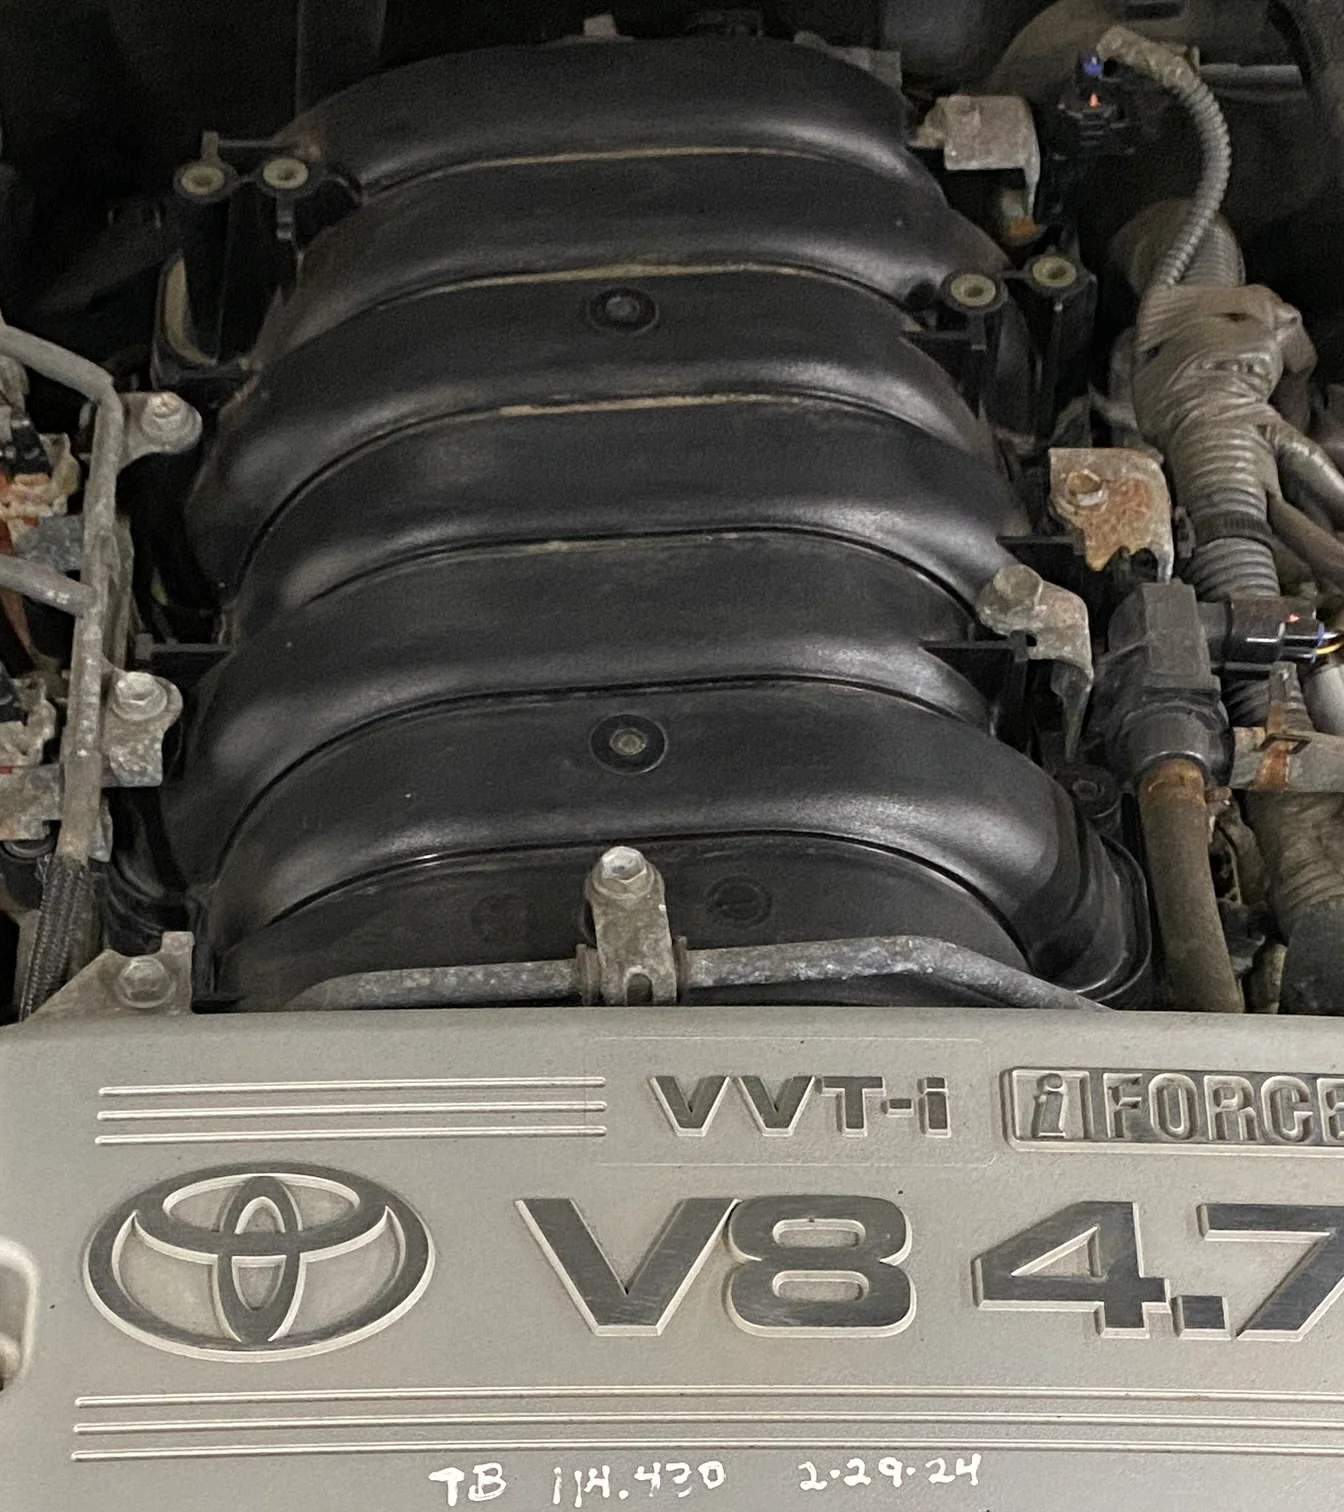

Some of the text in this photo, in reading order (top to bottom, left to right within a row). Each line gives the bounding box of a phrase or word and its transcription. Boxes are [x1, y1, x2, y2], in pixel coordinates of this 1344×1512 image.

[648, 1076, 952, 1138] VVT-i
[516, 1195, 916, 1338] V8
[429, 1462, 506, 1507] TB
